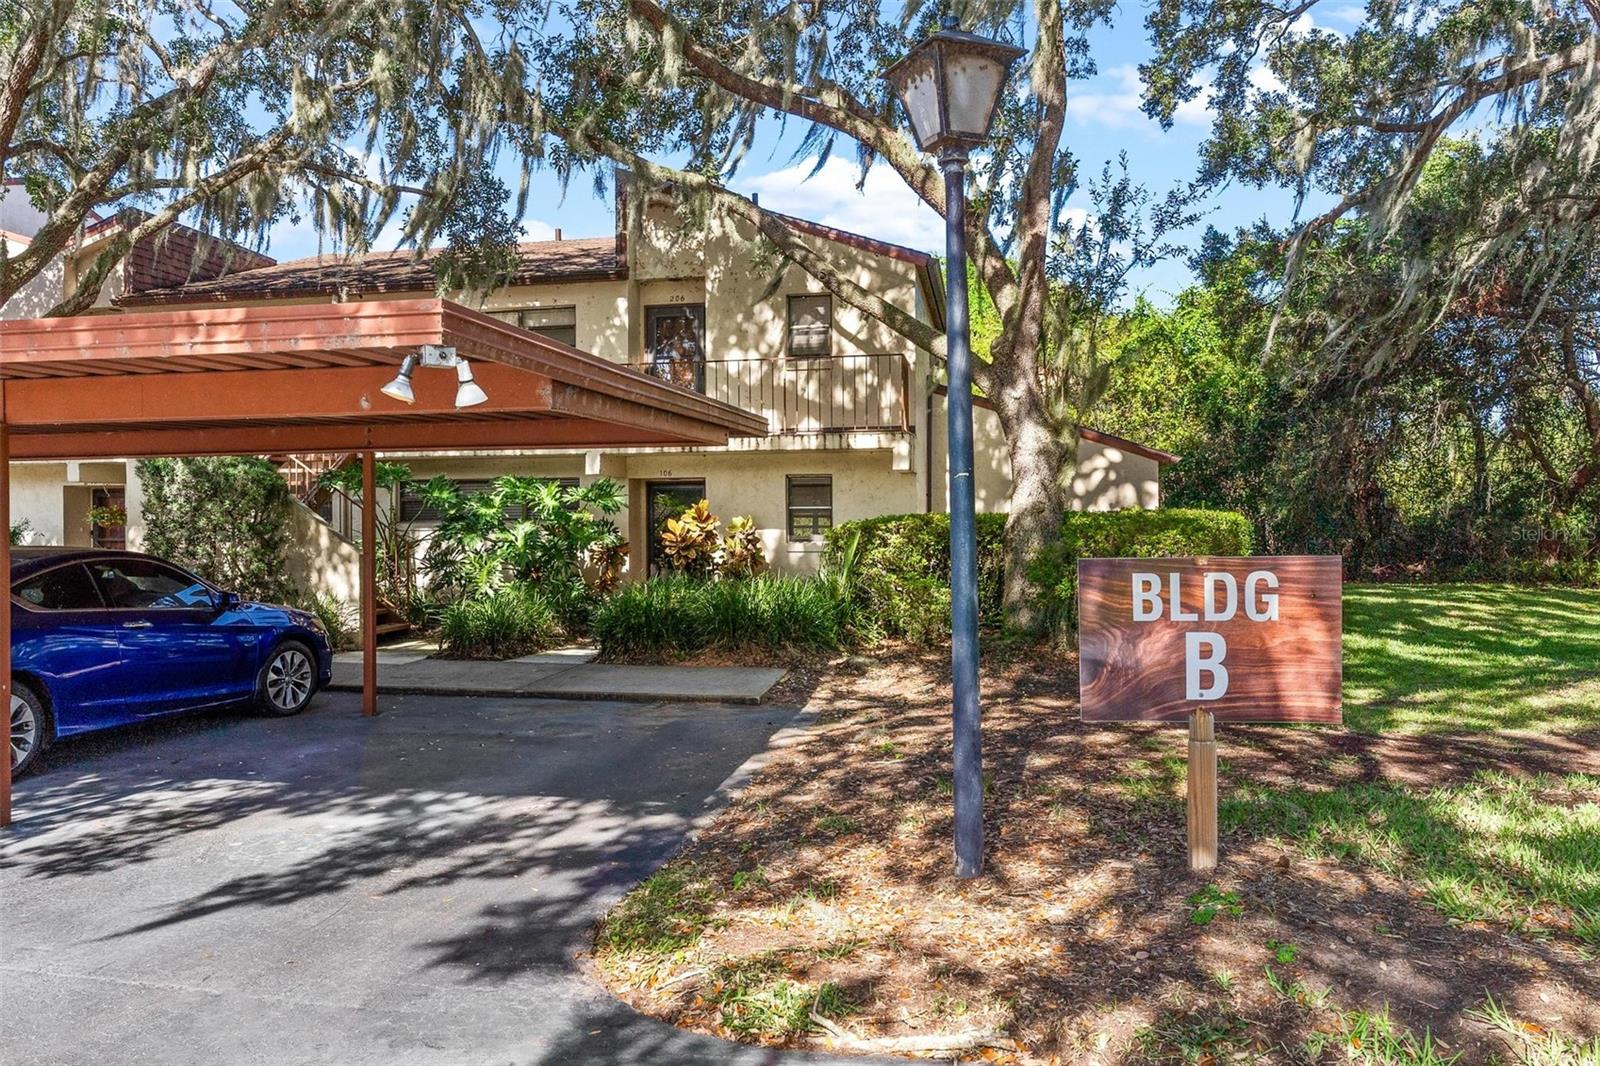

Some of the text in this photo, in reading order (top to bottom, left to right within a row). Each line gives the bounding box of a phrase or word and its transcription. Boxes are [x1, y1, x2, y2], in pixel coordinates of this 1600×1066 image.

[659, 469, 673, 477] 106
[1131, 570, 1280, 622] BLDG
[1185, 631, 1230, 701] B
